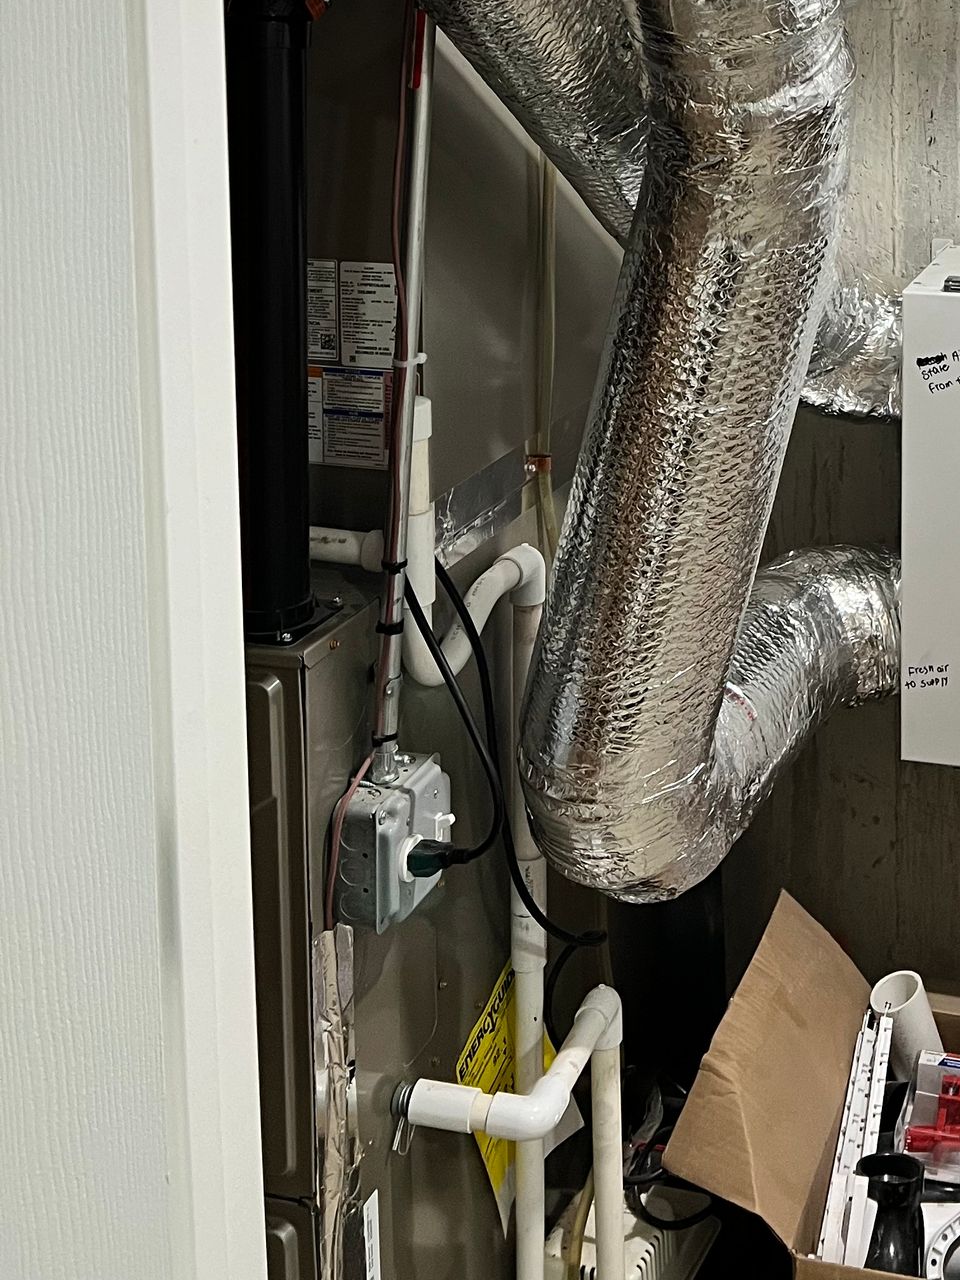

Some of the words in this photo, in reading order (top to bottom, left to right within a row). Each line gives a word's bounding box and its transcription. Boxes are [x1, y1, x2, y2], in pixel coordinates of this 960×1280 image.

[936, 664, 949, 673] air
[904, 680, 917, 690] to
[458, 968, 516, 1082] ENERGYGUID
